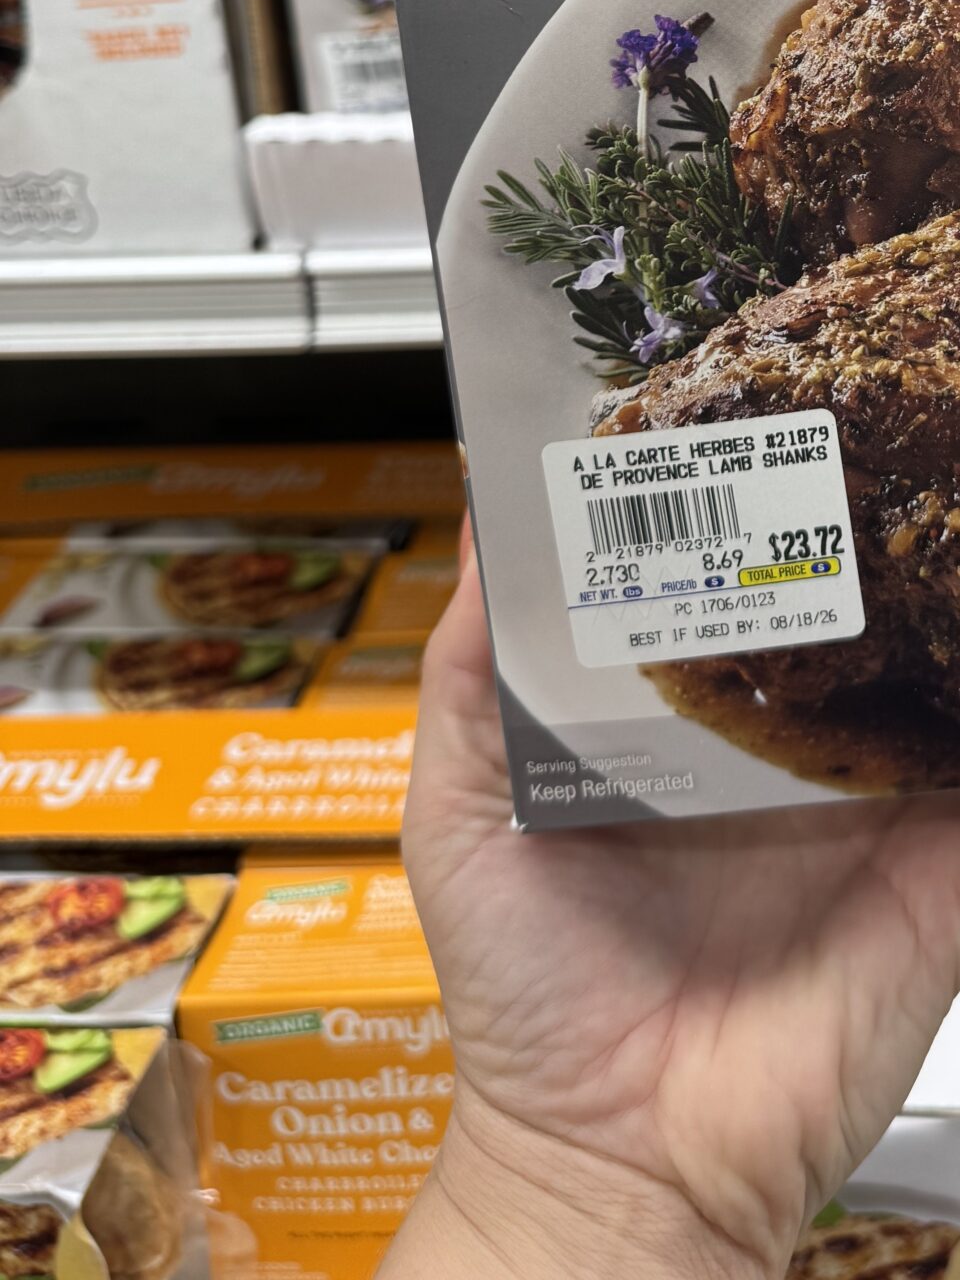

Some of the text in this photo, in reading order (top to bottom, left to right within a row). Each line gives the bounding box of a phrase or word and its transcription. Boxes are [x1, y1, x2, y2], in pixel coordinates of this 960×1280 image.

[572, 424, 831, 473] A LA CARTE HERBES #21879
[580, 444, 828, 491] DE PROVENCE LAMB SHANKS
[586, 531, 753, 564] 2 21879 02372 7
[701, 548, 745, 573] 8.69
[768, 523, 846, 563] $23.72
[579, 589, 600, 604] NET
[600, 587, 619, 602] WT.
[661, 578, 699, 594] PRICE/lb
[747, 568, 777, 583] TOTAL
[778, 564, 807, 579] PRICE
[700, 590, 777, 615] 1706/0123
[629, 608, 839, 648] BEST IF USED BY: 08/18/26
[0, 746, 161, 811] mylu
[526, 752, 652, 776] Serving Suggestion
[530, 771, 694, 803] Keep Refrigerated
[225, 1013, 316, 1038] ORGANIC
[215, 1065, 454, 1104] Caramelize
[271, 1104, 434, 1137] Onion &
[212, 1141, 374, 1169] Aged White
[253, 1195, 355, 1213] CHICKEN
